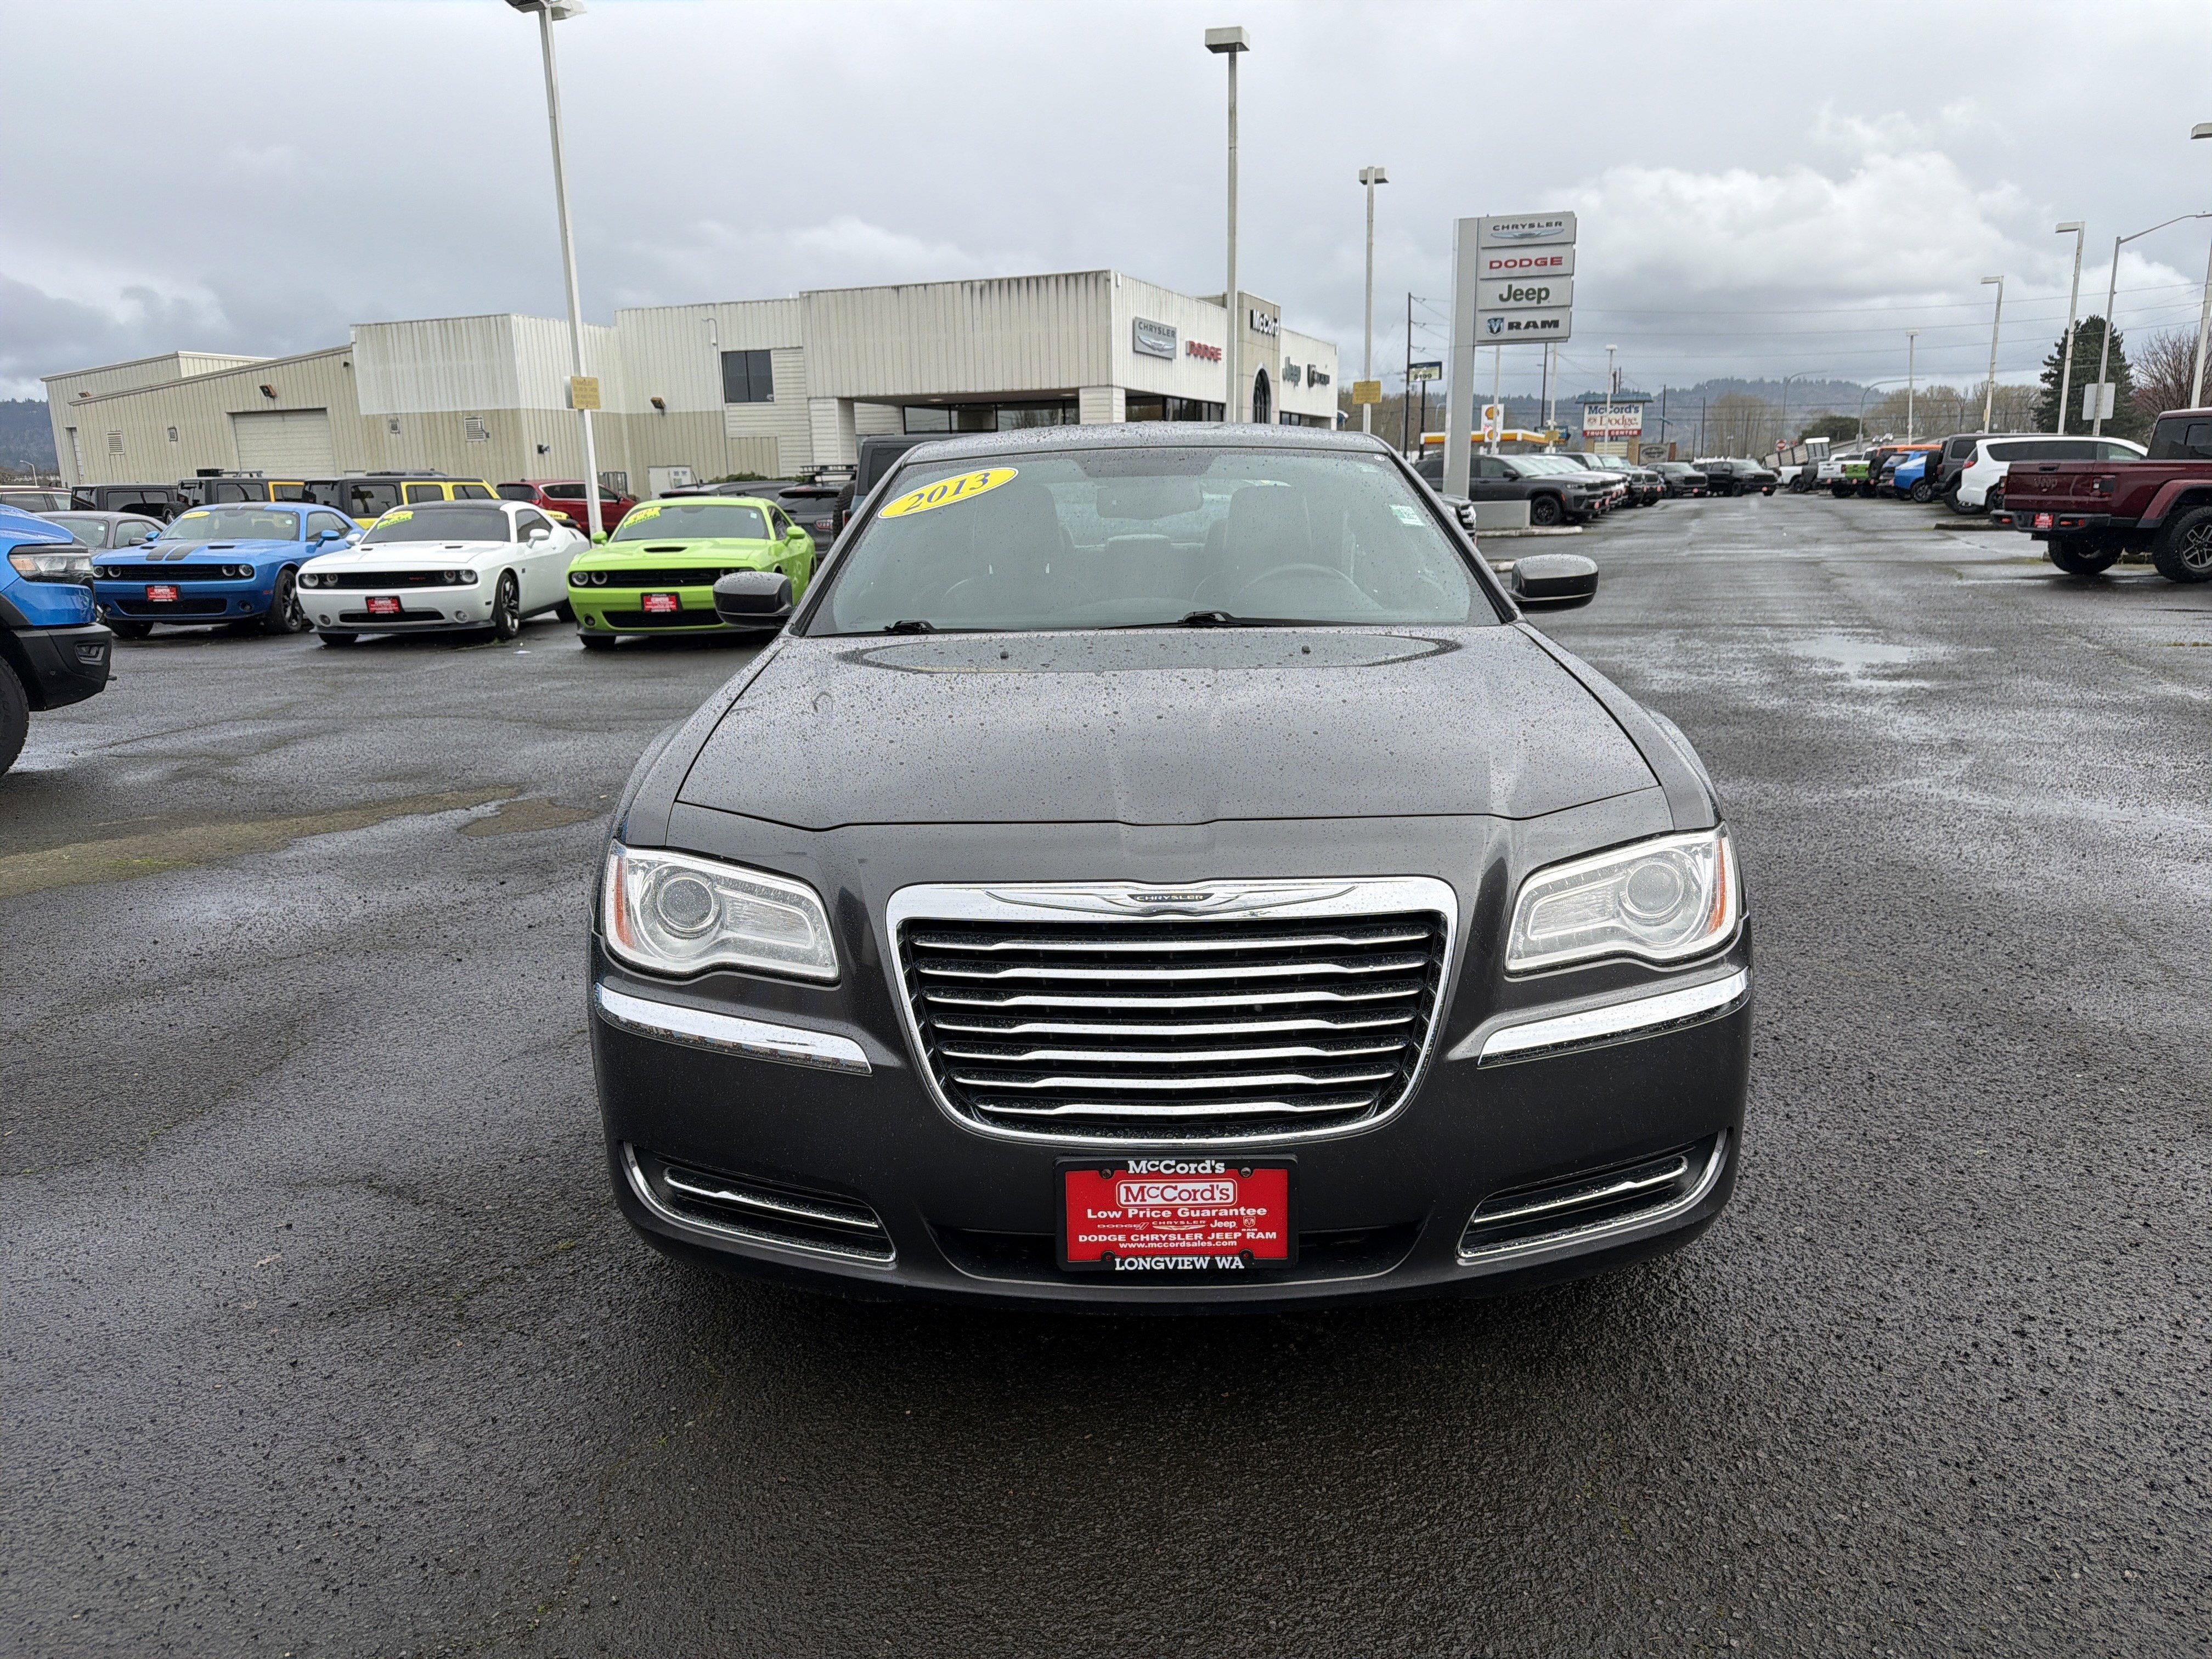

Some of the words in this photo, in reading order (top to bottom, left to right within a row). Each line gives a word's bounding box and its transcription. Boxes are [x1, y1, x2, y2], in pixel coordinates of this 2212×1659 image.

[1492, 221, 1562, 231] CHRYSLER
[1489, 256, 1563, 269] DODGE
[1499, 284, 1550, 304] Jeep
[1138, 321, 1176, 338] CHRYSLER
[1251, 309, 1279, 336] McCord
[1508, 319, 1560, 330] RAM
[1187, 340, 1222, 361] DODGE
[902, 472, 990, 512] 2013
[1127, 1160, 1226, 1175] McCord's
[1123, 1184, 1230, 1202] McCord's
[1087, 1209, 1122, 1218] Low
[1127, 1208, 1172, 1218] Price
[1177, 1206, 1267, 1217] Guarantee
[1210, 1220, 1237, 1229] Jeep
[1130, 1233, 1203, 1242] CHRYSLER
[1115, 1257, 1210, 1271] LONGVIEW
[1215, 1256, 1245, 1269] WA
